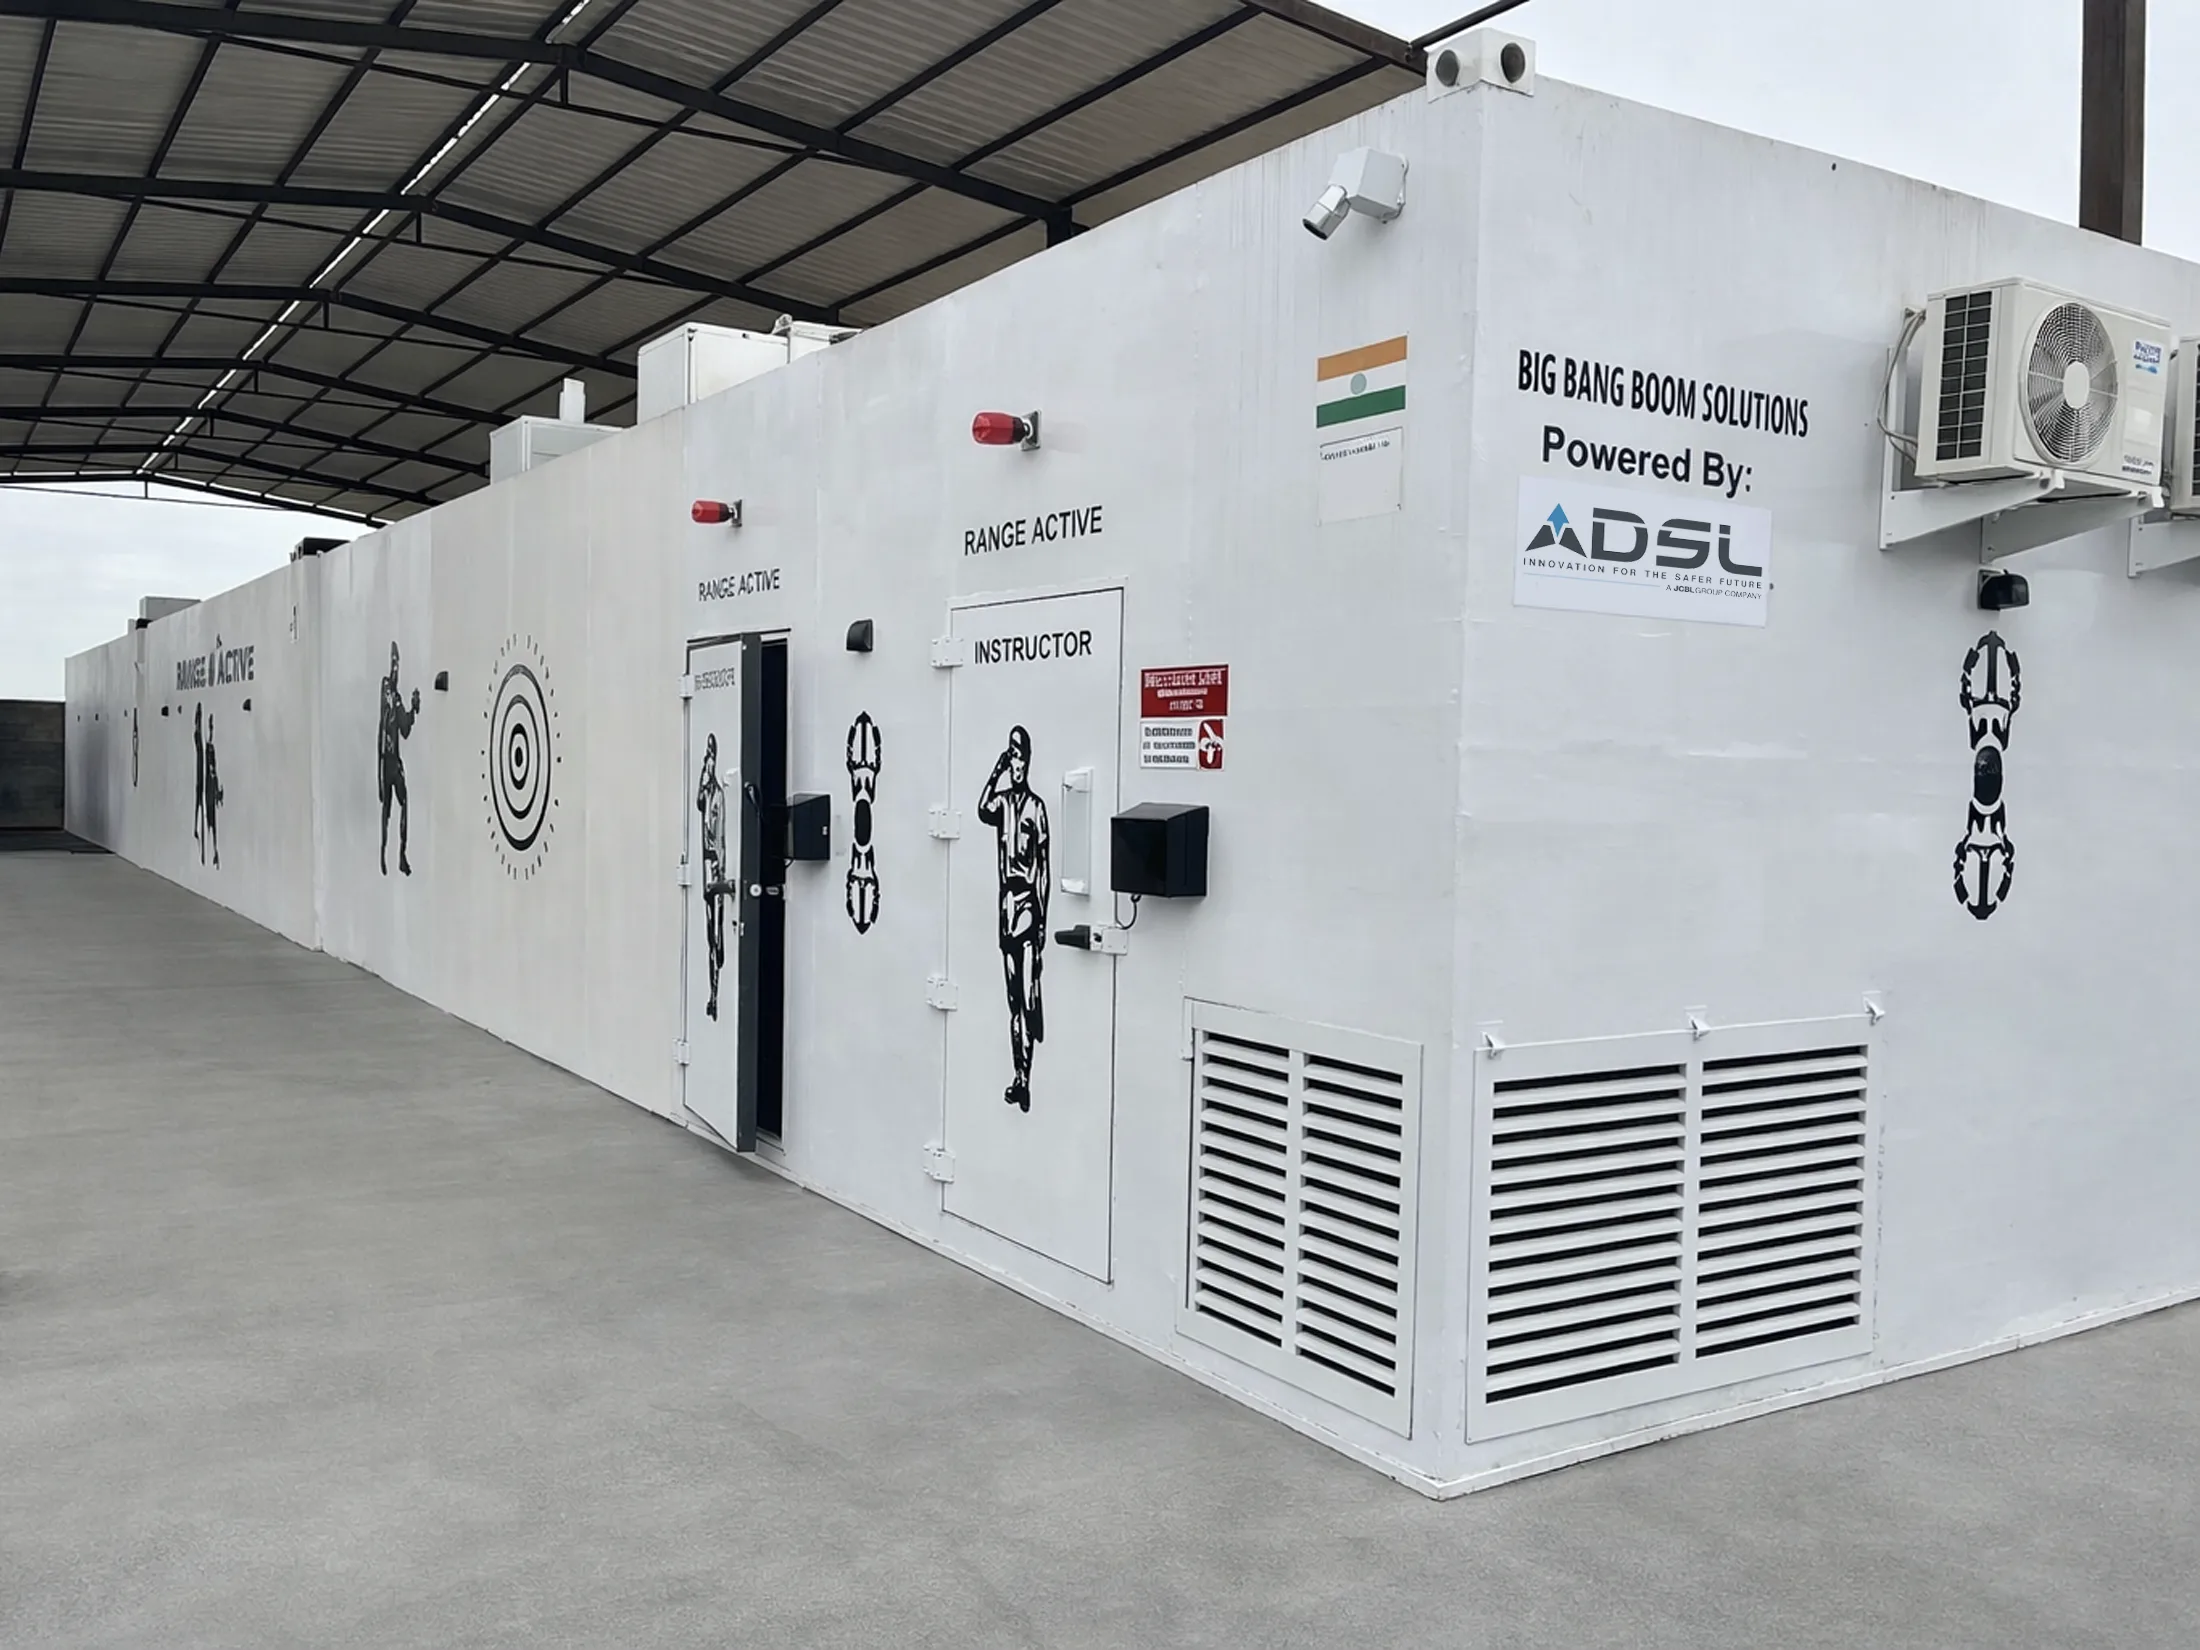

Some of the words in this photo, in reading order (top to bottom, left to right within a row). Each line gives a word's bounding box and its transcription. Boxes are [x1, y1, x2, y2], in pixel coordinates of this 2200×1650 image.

[1518, 349, 1556, 395] BIG
[1564, 357, 1624, 407] BANG
[1631, 370, 1697, 420] BOOM
[1702, 382, 1809, 438] SOLUTIONS
[1542, 425, 1691, 483] Powered
[1703, 450, 1753, 499] By:
[964, 519, 1027, 556] RANGE
[1031, 505, 1103, 544] ACTIVE
[698, 575, 735, 602] RANGE
[737, 568, 780, 596] ACTIVE
[1523, 557, 1605, 573] INNOVATION
[1613, 566, 1637, 576] FOR
[1644, 569, 1667, 579] THE
[1674, 572, 1712, 584] SAFER
[1719, 577, 1762, 589] FUTURE
[1724, 589, 1762, 600] COMPANY
[974, 629, 1093, 664] INSTRUCTOR
